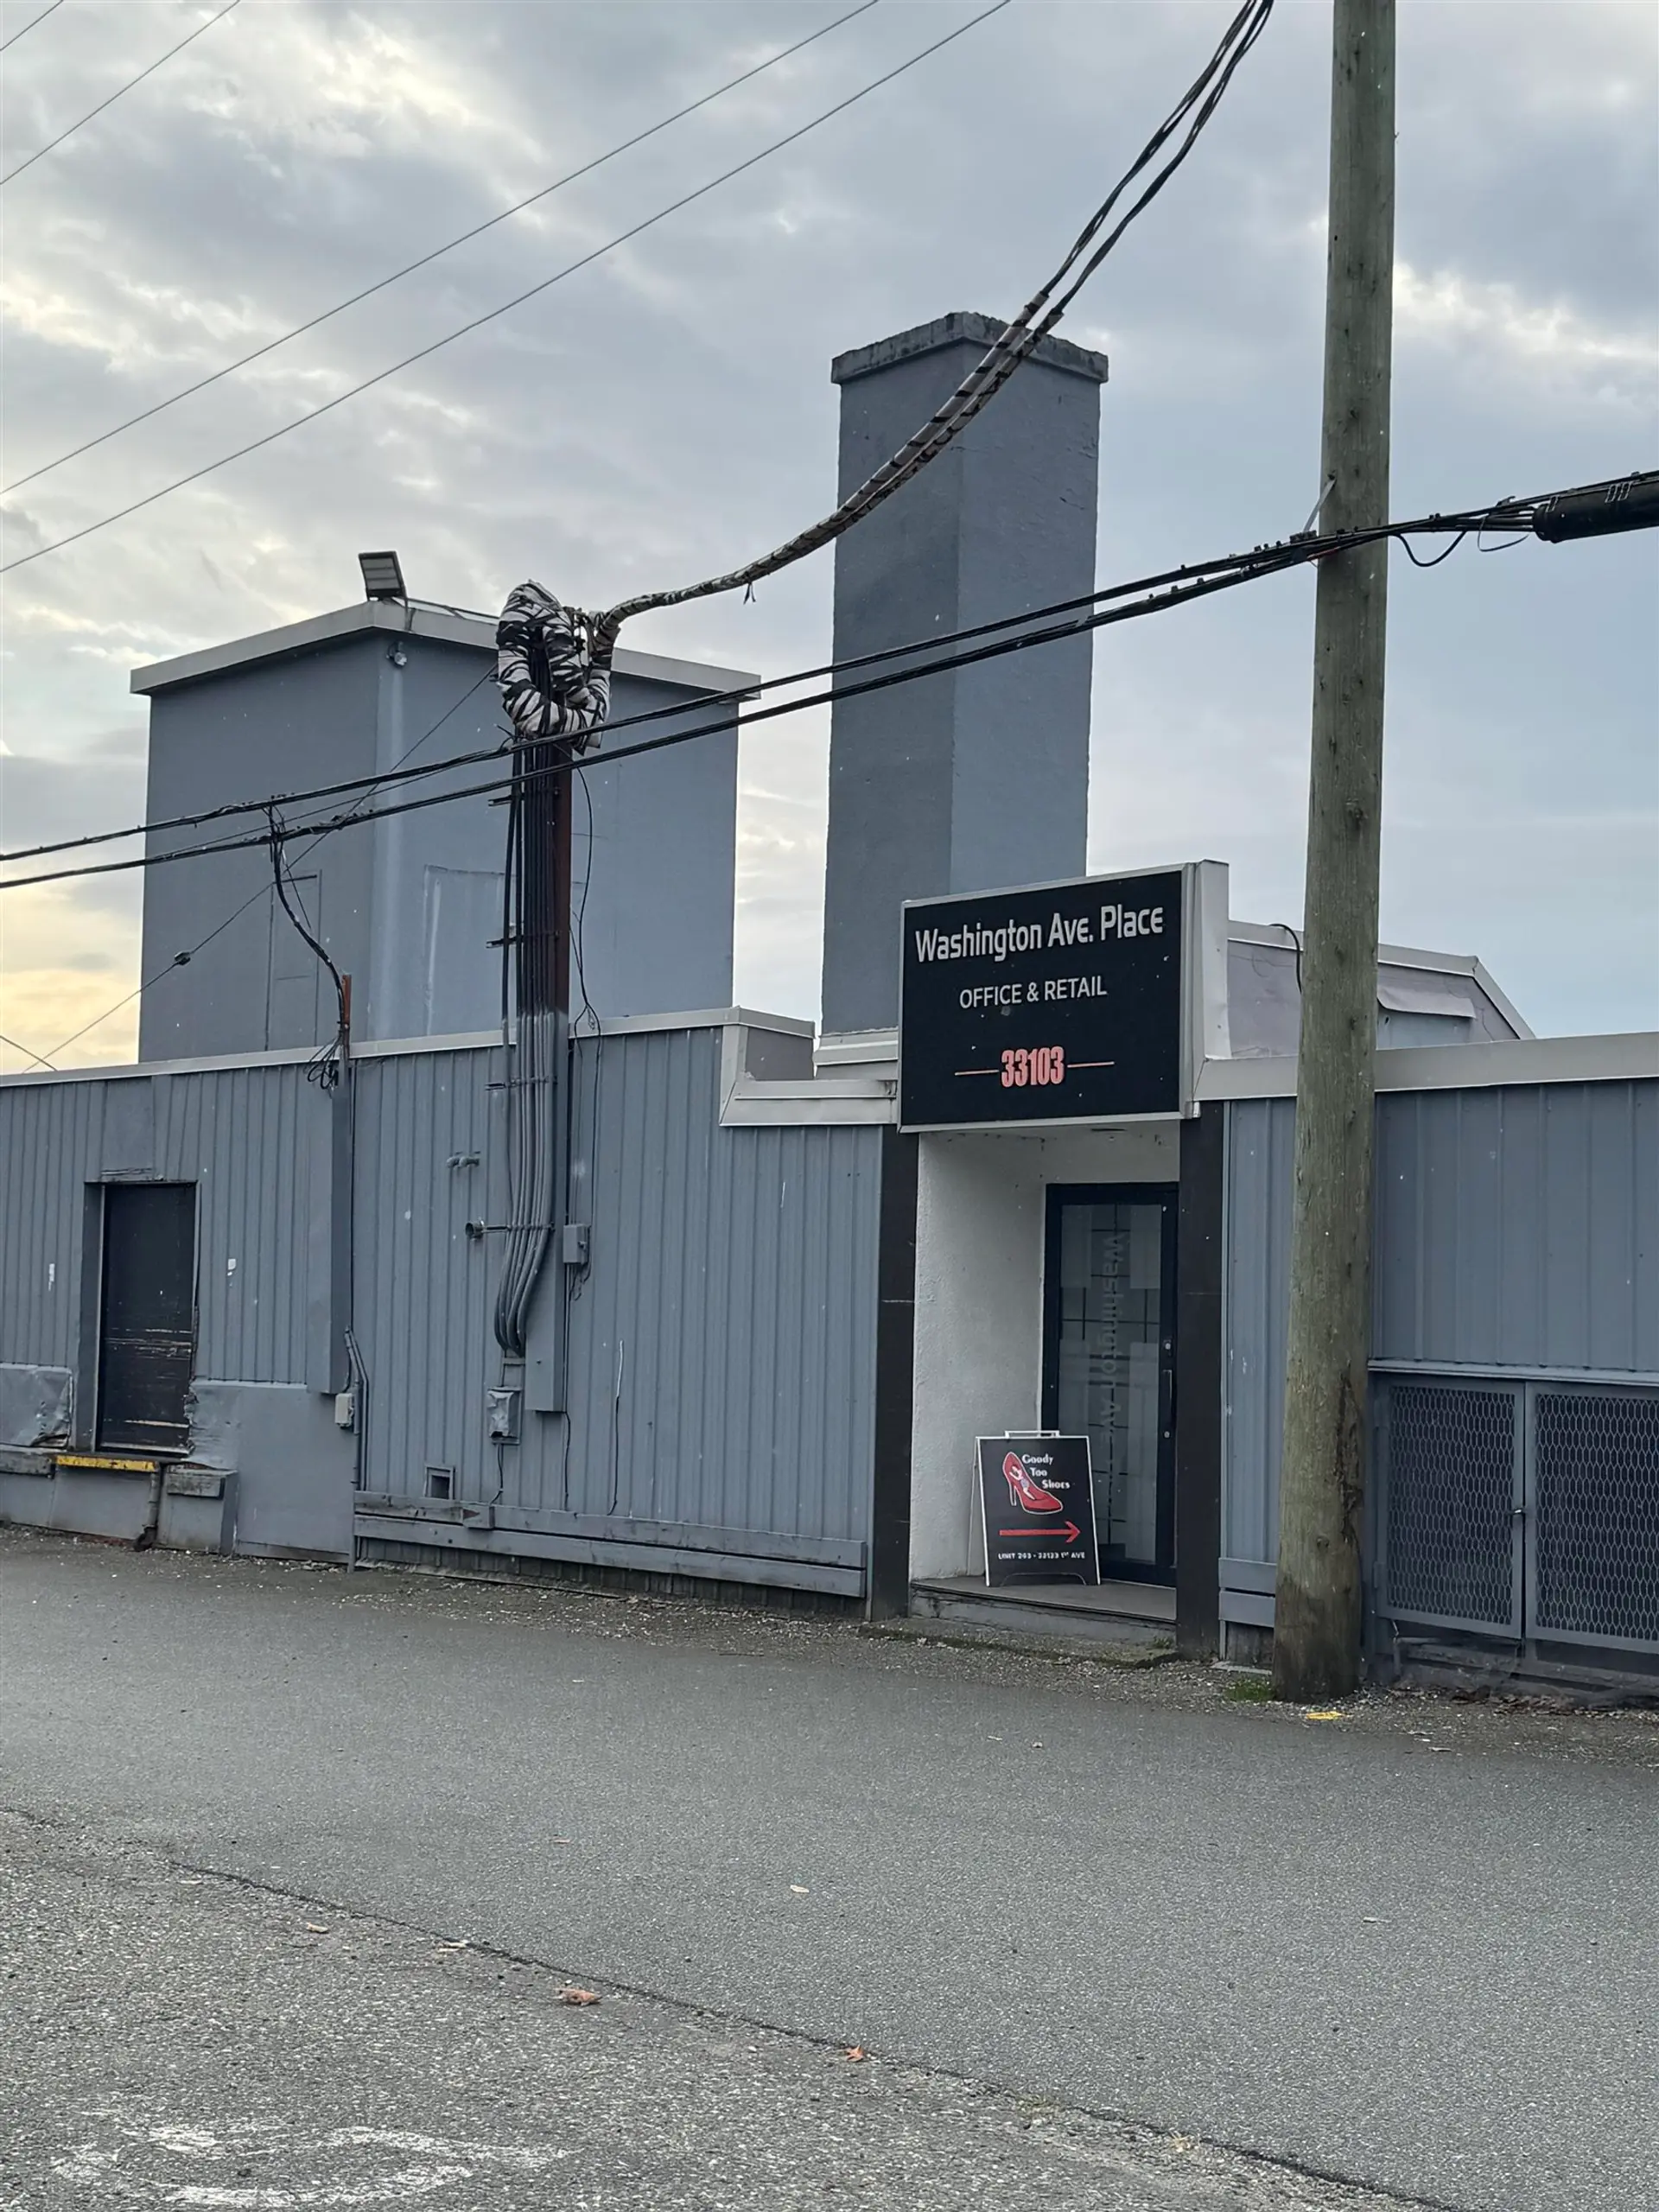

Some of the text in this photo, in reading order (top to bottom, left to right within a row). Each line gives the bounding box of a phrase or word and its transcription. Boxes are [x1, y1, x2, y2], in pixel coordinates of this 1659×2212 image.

[915, 904, 1163, 963] Washington Ave. Place
[959, 976, 1107, 1009] OFFICE & RETAIL
[1001, 1046, 1065, 1088] 33103
[1022, 1453, 1053, 1465] Goody
[1030, 1467, 1047, 1477] Too
[1042, 1479, 1071, 1489] Shoes
